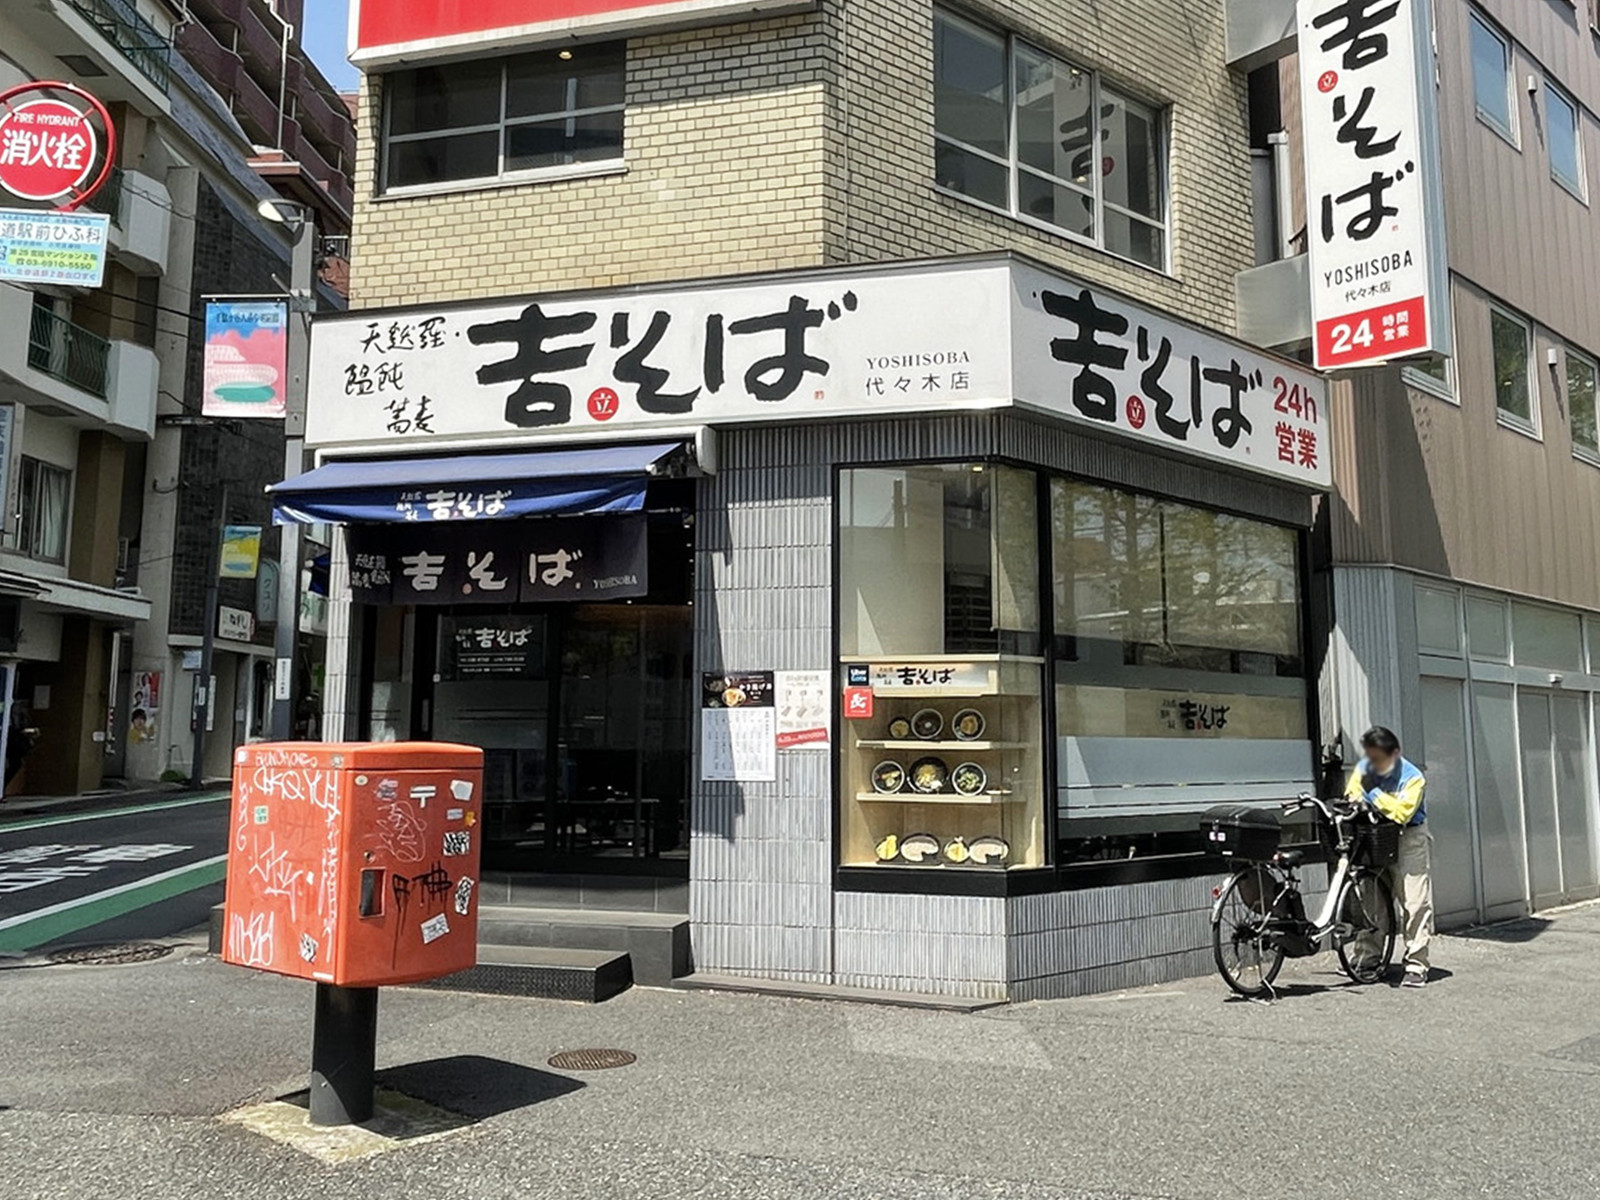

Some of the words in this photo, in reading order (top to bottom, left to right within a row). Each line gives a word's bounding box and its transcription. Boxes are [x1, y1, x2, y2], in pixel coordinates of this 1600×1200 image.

[13, 112, 35, 124] FIRE
[36, 113, 80, 127] HYDRANT
[1, 128, 86, 170] 消火栓
[1324, 250, 1413, 288] YOSHISOBA
[1345, 280, 1391, 303] 代々木店
[1381, 310, 1409, 327] 時間
[1382, 325, 1409, 342] 営業
[1330, 318, 1374, 354] 24
[467, 290, 858, 428] 吉そば
[866, 351, 970, 370] YOSHISOBA
[1041, 290, 1263, 448] 吉そば
[865, 371, 970, 396] 代々木店
[1272, 376, 1318, 424] 24h
[1275, 421, 1318, 470] 営業
[425, 489, 513, 521] 吉そば
[401, 548, 584, 592] 吉そば
[475, 626, 533, 648] 吉そば
[896, 666, 956, 685] 吉そば
